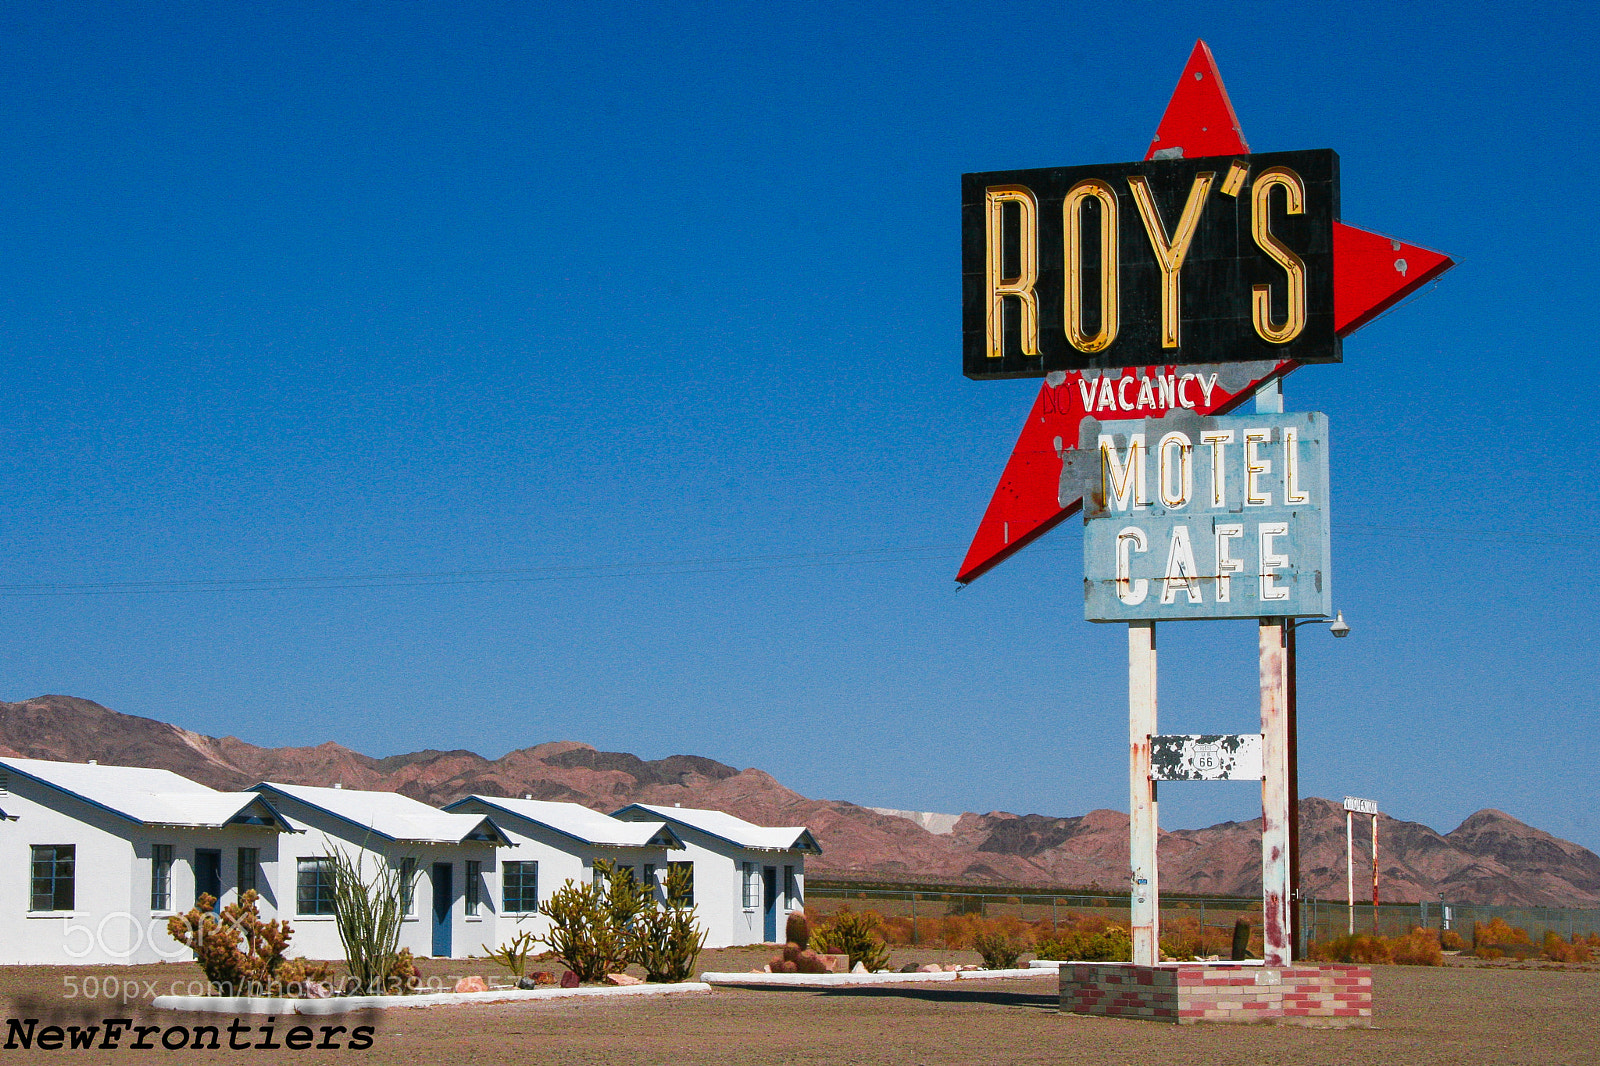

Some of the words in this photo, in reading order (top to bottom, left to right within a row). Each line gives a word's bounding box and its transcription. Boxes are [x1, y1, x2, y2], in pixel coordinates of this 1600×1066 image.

[984, 159, 1307, 359] ROY'S
[1078, 373, 1217, 412] VACANCY
[1097, 427, 1310, 512] MOTEL
[1115, 521, 1291, 606] CAFE
[1199, 757, 1213, 768] 66
